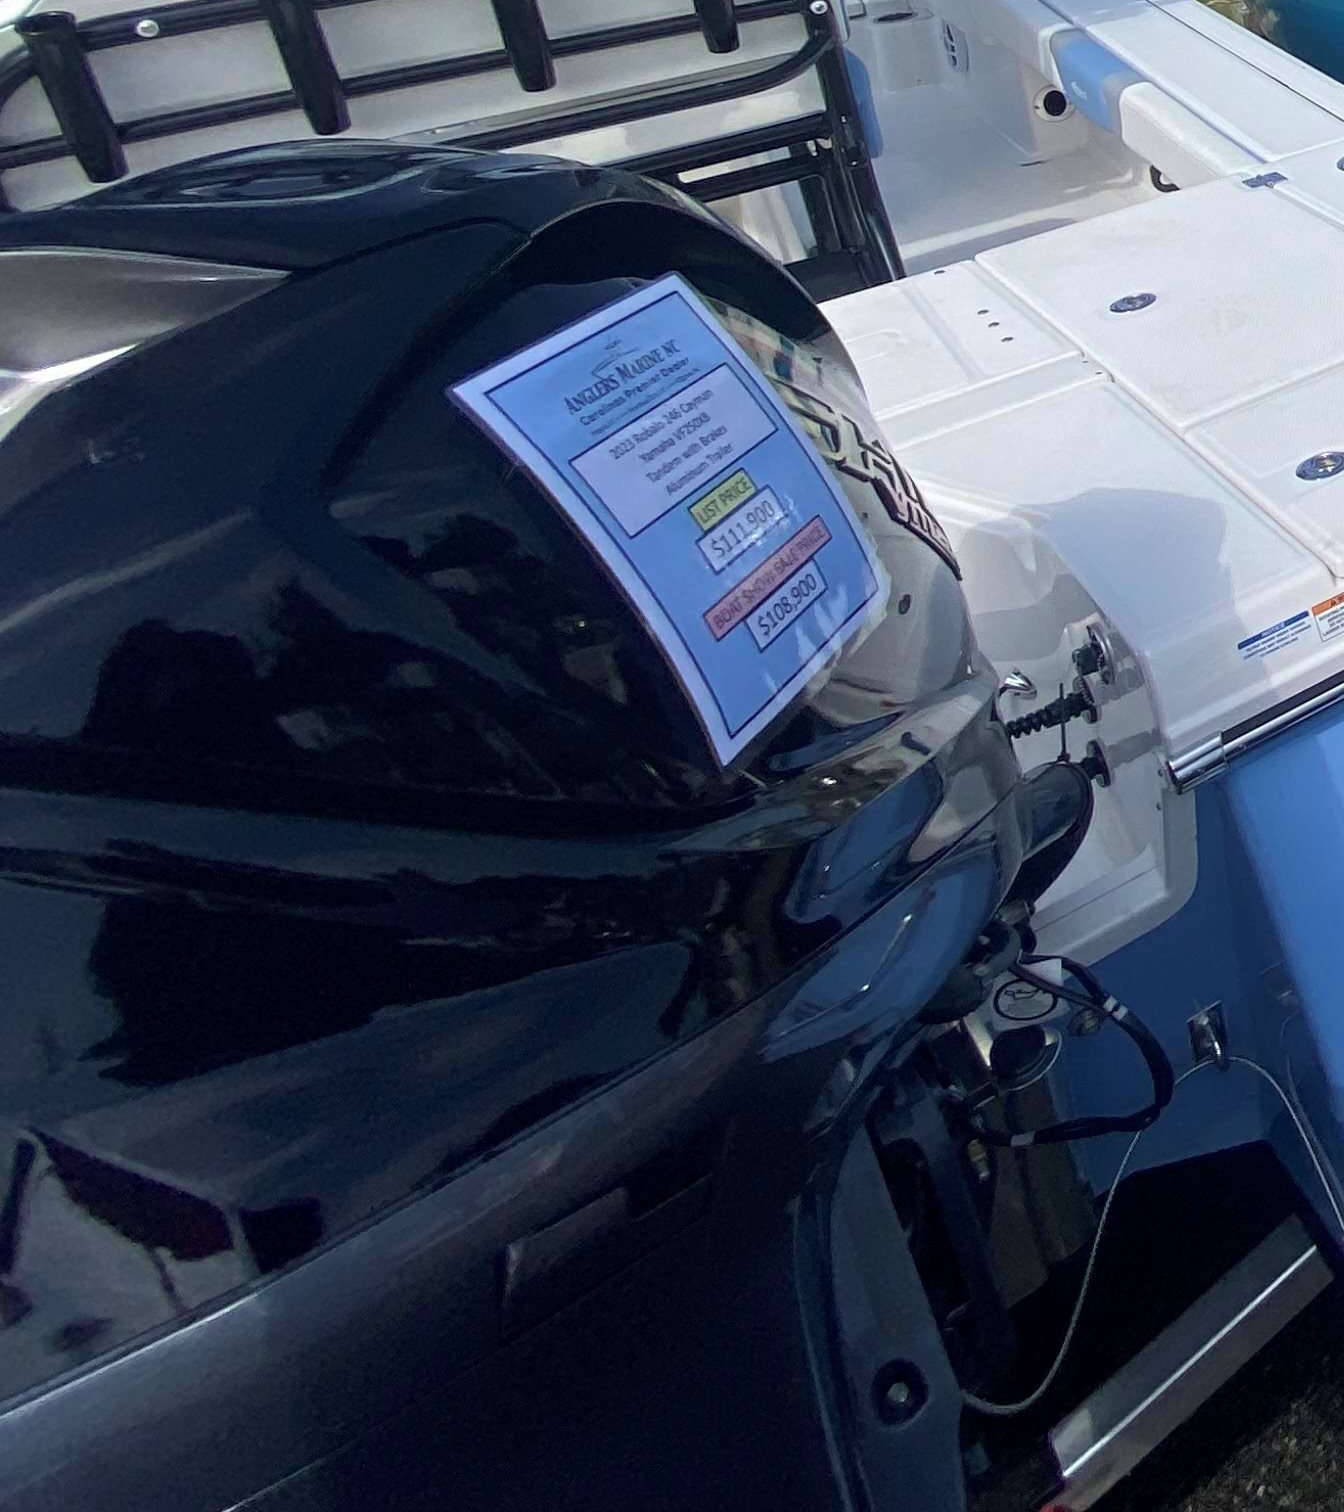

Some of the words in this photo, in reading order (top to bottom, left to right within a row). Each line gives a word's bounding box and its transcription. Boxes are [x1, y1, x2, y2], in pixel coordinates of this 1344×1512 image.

[564, 374, 620, 415] ANGLERS
[615, 347, 665, 384] MARINE
[661, 339, 681, 357] NC
[698, 499, 721, 524] LIST
[719, 476, 753, 507] PRICE
[712, 599, 743, 630] BOAT
[742, 572, 776, 604] SHOW
[773, 548, 800, 574] SALE
[799, 527, 826, 554] PRICE
[758, 573, 817, 637] $108,900
